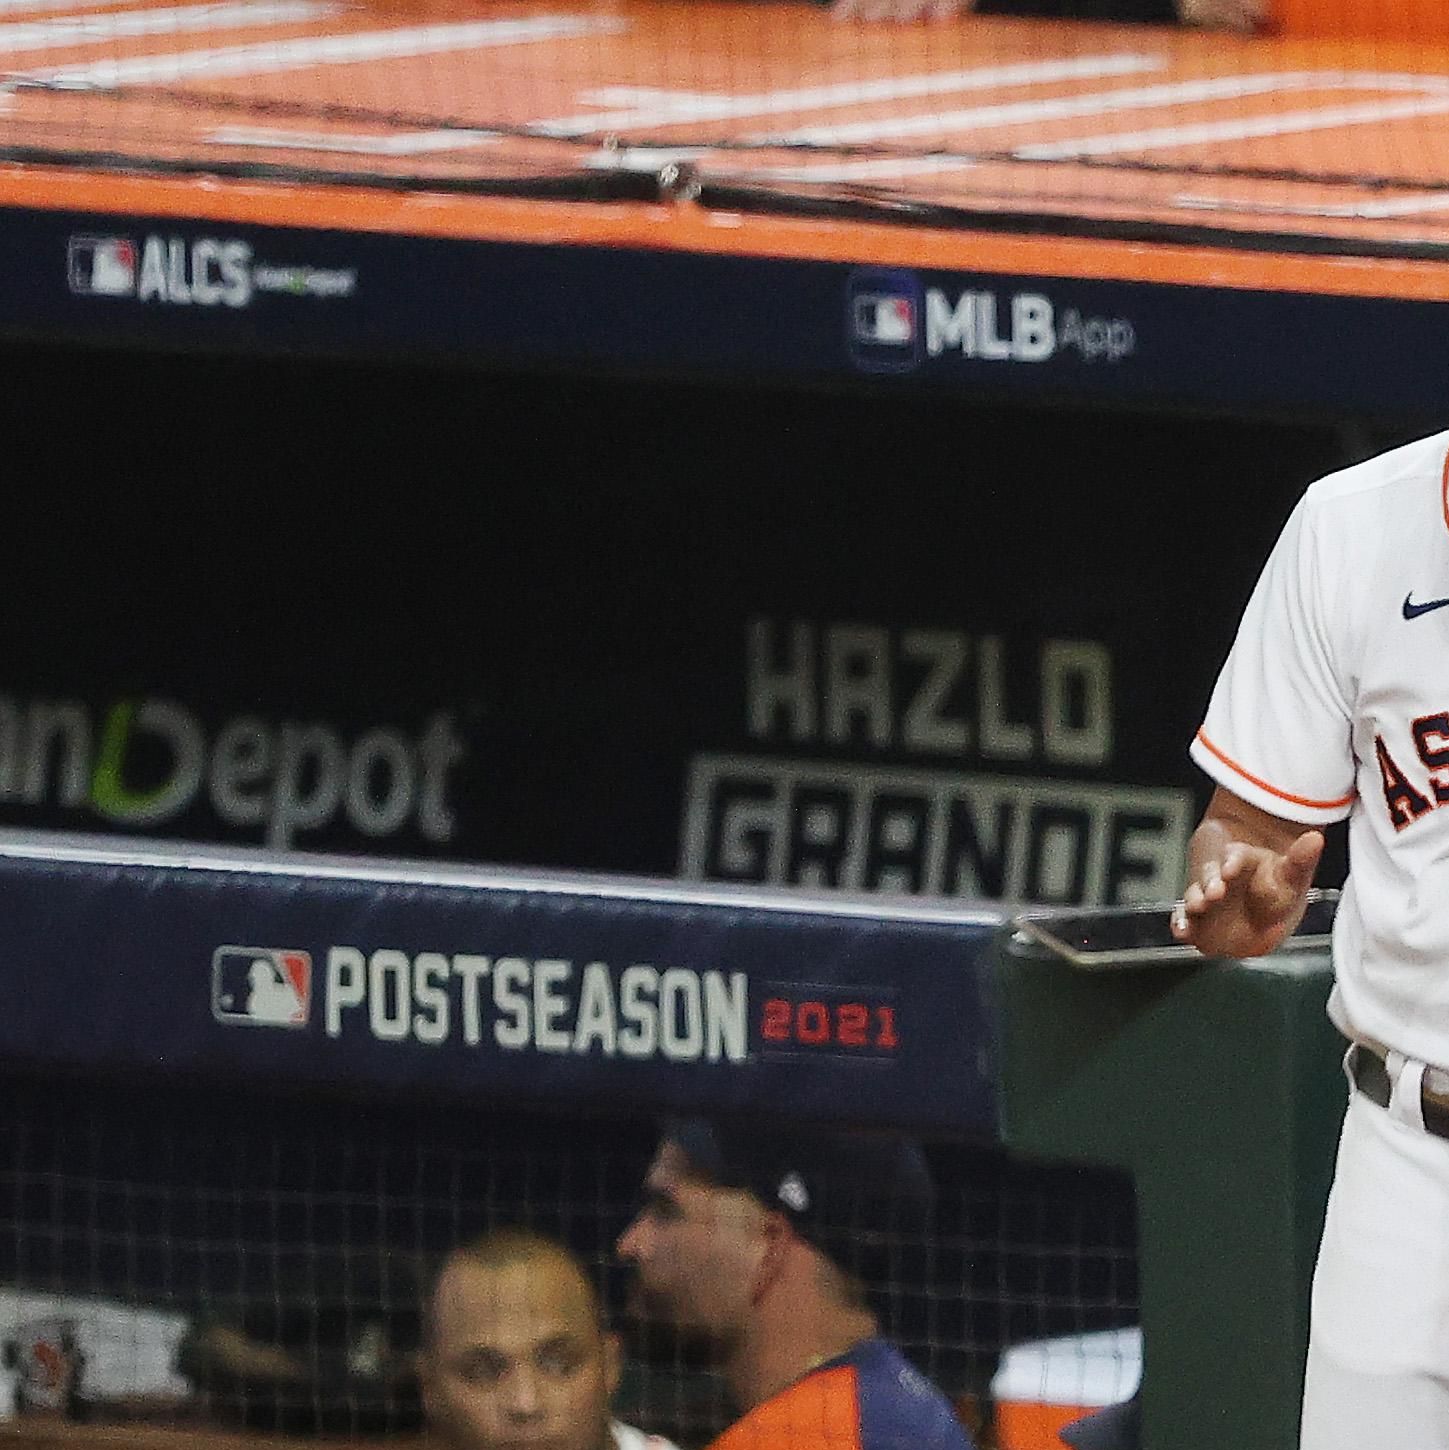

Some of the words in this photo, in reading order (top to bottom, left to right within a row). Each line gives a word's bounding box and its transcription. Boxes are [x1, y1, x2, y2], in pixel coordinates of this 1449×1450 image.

[138, 236, 251, 307] ALCS
[925, 287, 1056, 361] MLB
[1058, 305, 1136, 365] App
[746, 615, 1113, 764] HAZLO
[711, 770, 1168, 901] GRANDE
[324, 945, 748, 1064] POSTSEASON
[761, 998, 902, 1050] 2021
